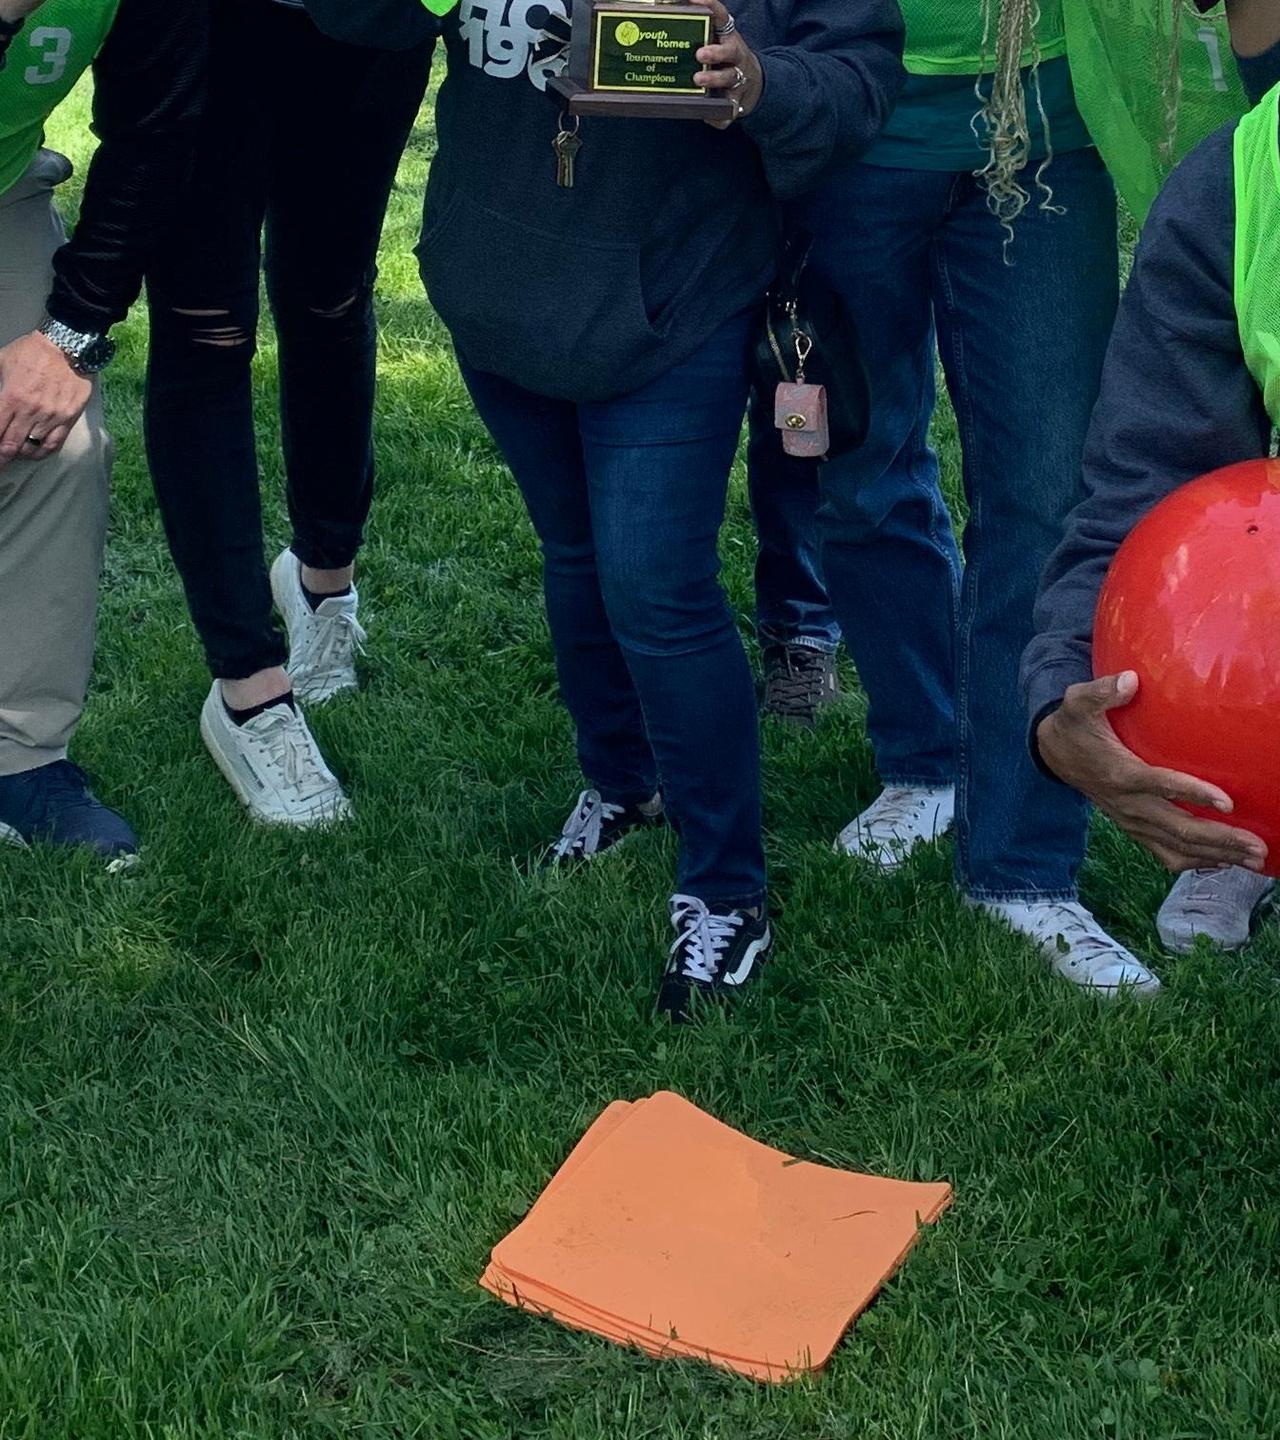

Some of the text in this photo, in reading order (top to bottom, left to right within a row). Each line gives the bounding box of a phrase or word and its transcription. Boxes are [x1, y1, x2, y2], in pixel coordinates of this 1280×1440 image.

[639, 30, 668, 41] youth
[656, 39, 690, 49] homes
[24, 26, 73, 85] 3
[624, 52, 678, 63] Tournament
[646, 63, 656, 72] of
[624, 72, 676, 84] Champions
